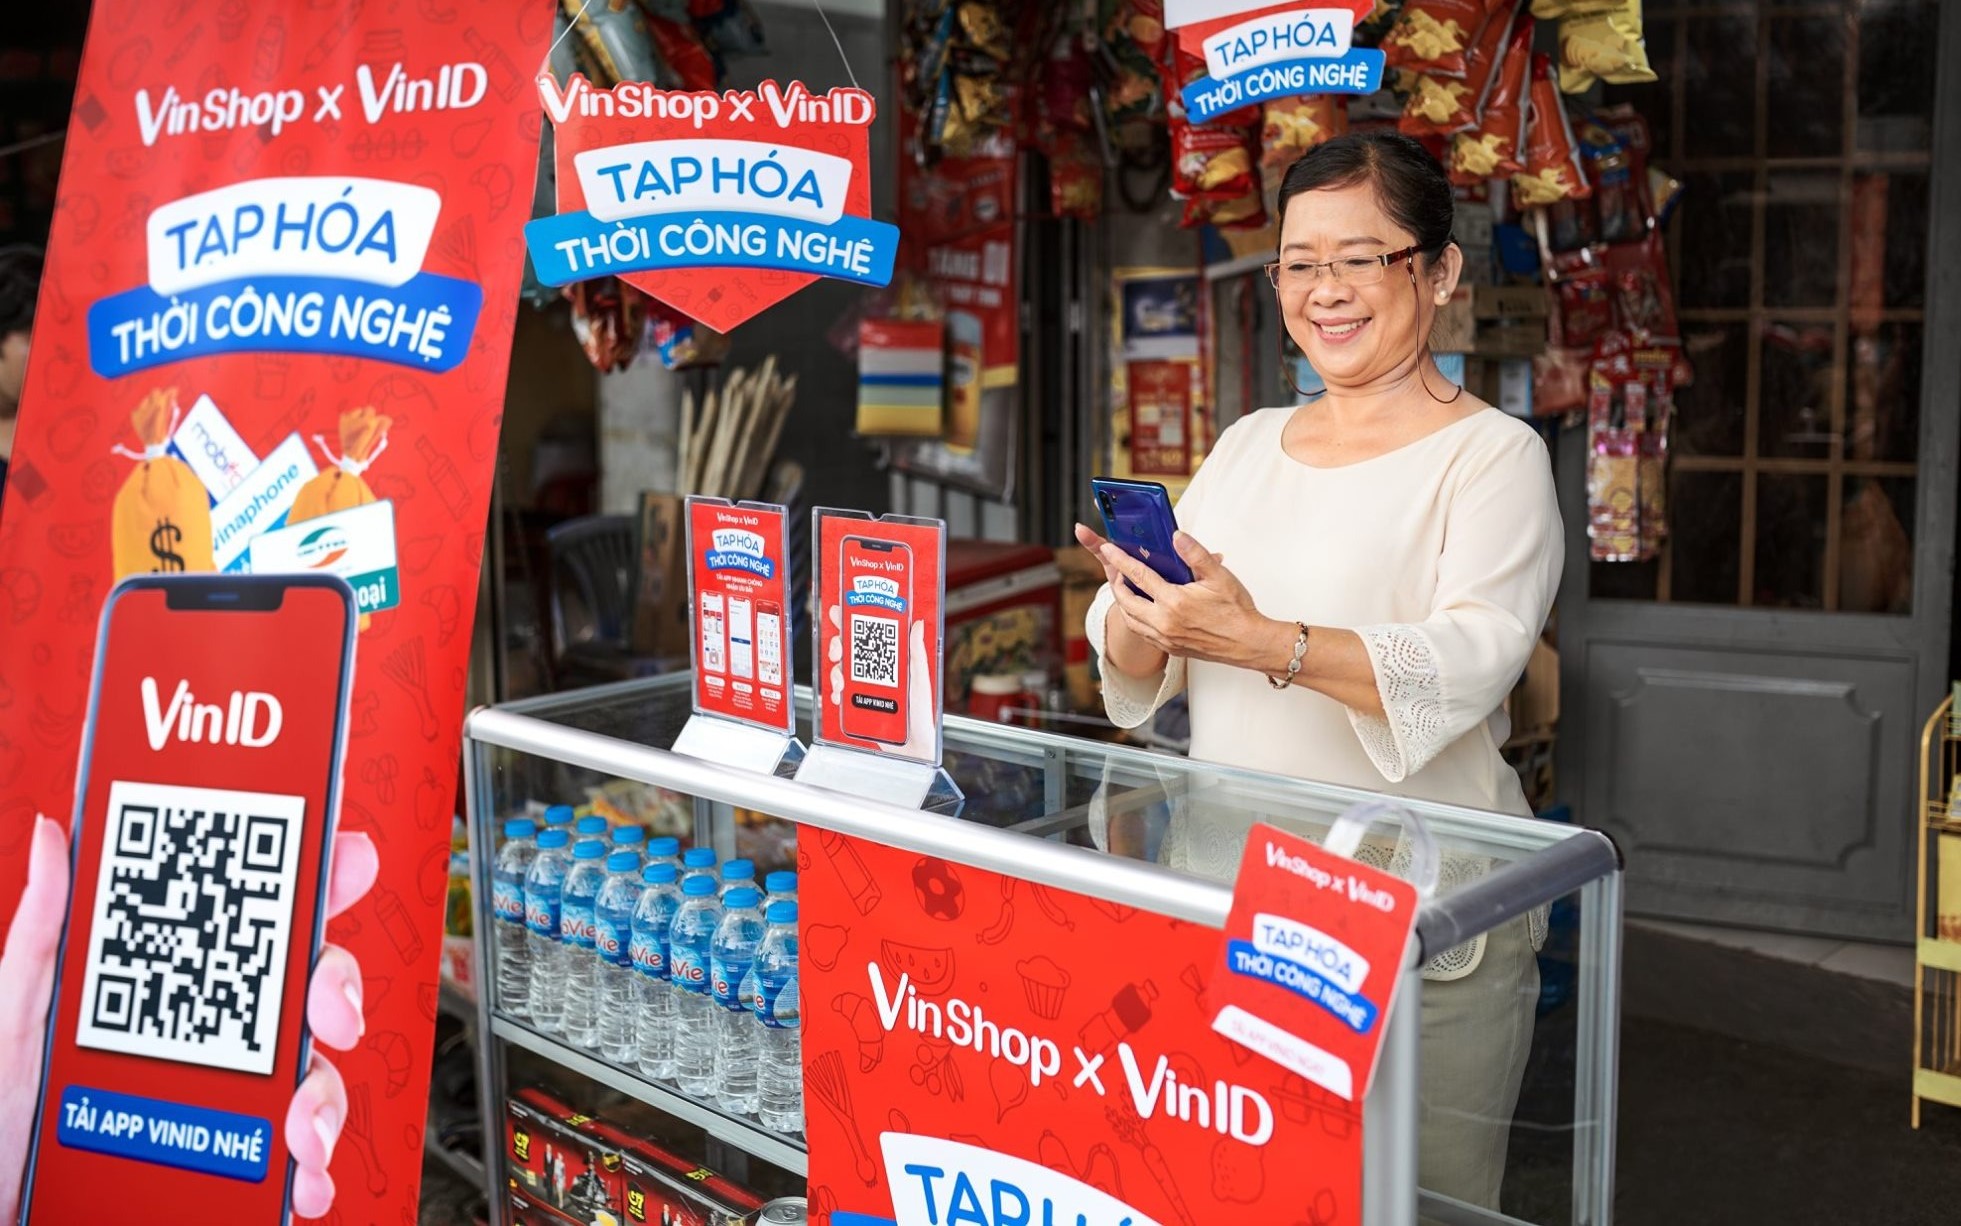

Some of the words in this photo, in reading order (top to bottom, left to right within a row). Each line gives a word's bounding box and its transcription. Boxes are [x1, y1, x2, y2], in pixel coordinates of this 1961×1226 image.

[1273, 13, 1337, 50] HÓA
[136, 87, 302, 146] VinShop
[313, 86, 345, 122] x
[356, 62, 488, 124] VinID
[539, 76, 719, 128] VinShop
[729, 95, 755, 123] x
[759, 81, 872, 128] VinID
[1194, 77, 1243, 115] THỜI
[1245, 65, 1304, 97] CÔNG
[1309, 61, 1369, 91] NGHỆ
[597, 156, 702, 203] TẠP
[712, 150, 824, 209] HÓA
[165, 203, 265, 270] TẠP
[274, 185, 398, 264] HÓA
[554, 222, 650, 272] THỜI
[659, 218, 767, 258] CÔNG
[776, 228, 875, 276] NGHỆ
[111, 294, 198, 364] THỜI
[205, 285, 324, 341] CÔNG
[330, 297, 452, 363] NGHỆ
[727, 553, 748, 567] CÔNG
[850, 556, 878, 571] VinShop
[885, 561, 904, 572] VinID
[358, 575, 387, 609] oại
[866, 594, 884, 605] CÔNG
[140, 677, 283, 751] VinID
[1265, 841, 1330, 889] VinShop
[1347, 875, 1395, 912] VinID
[1274, 961, 1322, 998] CÔNG
[867, 961, 1061, 1087] VinShop
[1072, 1045, 1106, 1096] x
[1117, 1042, 1274, 1146] VinID
[65, 1096, 97, 1132] TẢI
[99, 1110, 144, 1139] APP
[148, 1117, 210, 1152] VINID
[213, 1128, 263, 1163] NHÉ
